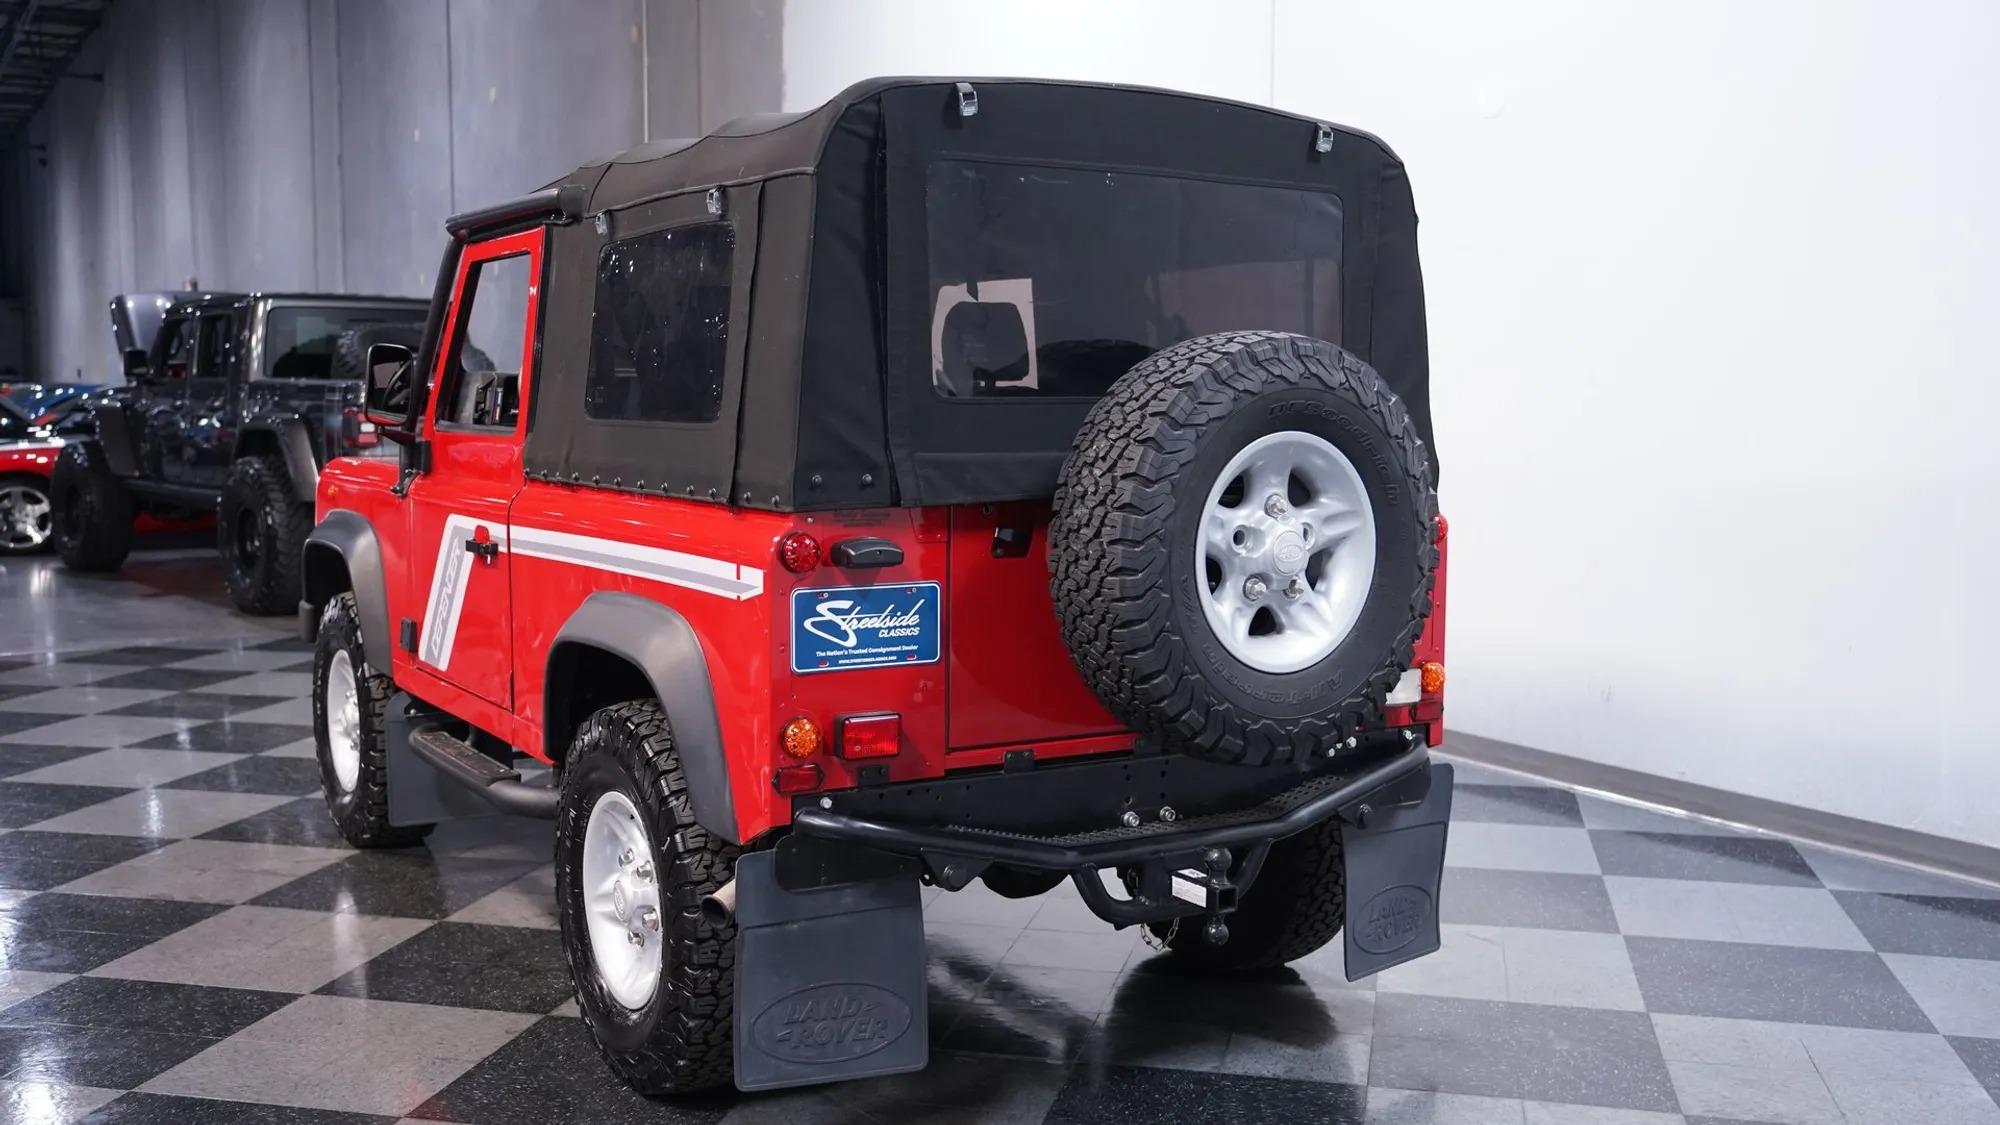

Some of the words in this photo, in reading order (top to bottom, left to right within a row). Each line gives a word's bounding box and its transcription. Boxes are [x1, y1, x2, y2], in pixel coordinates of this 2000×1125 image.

[803, 598, 925, 647] Streetside
[878, 626, 920, 638] CLASSICS
[868, 645, 902, 654] Consignment
